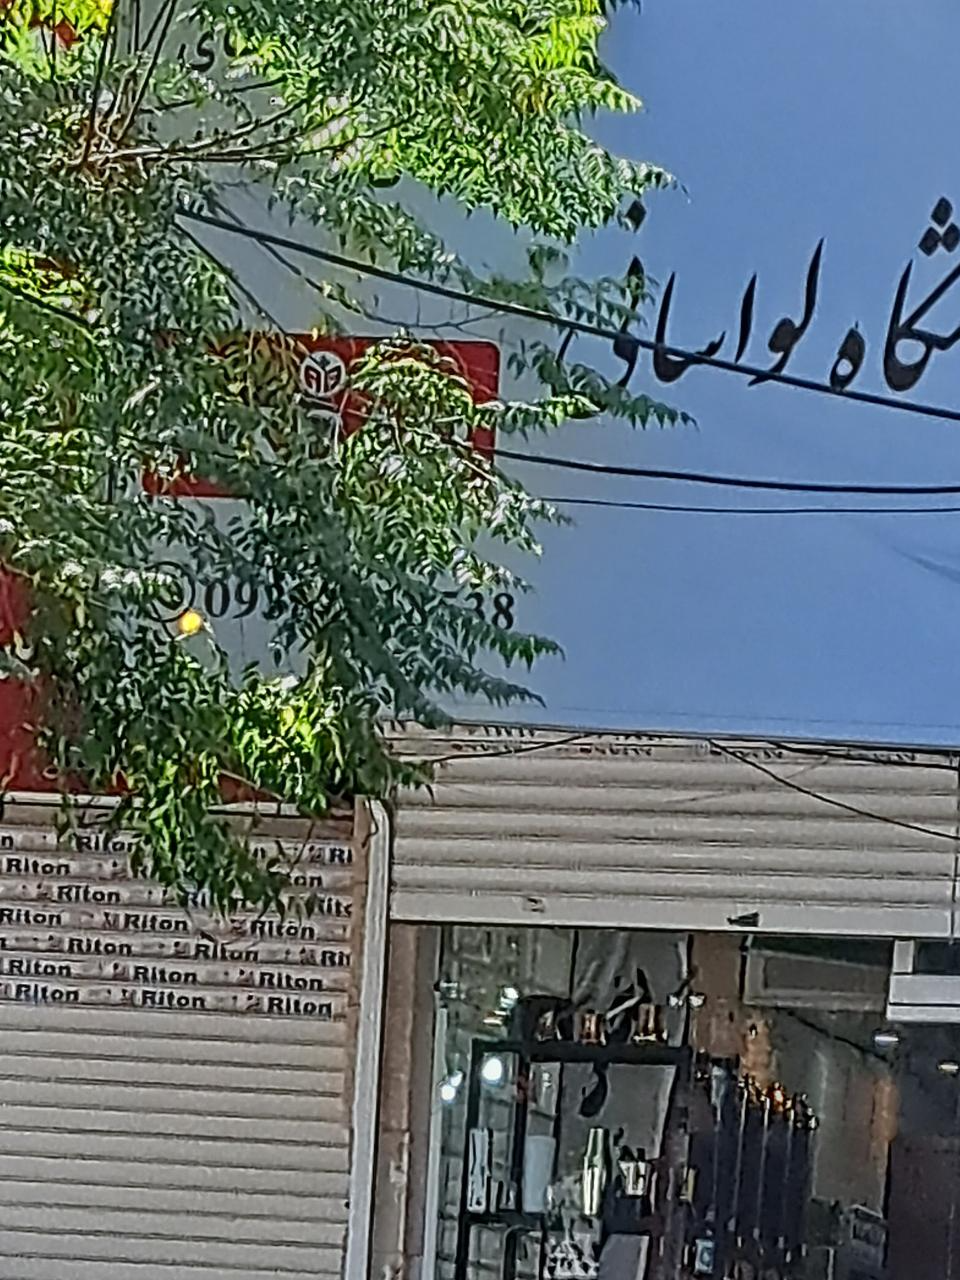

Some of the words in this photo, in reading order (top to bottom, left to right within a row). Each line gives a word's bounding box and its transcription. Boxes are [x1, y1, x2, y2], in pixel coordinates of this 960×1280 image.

[6, 857, 70, 875] Riton
[57, 885, 121, 903] Riton
[124, 913, 188, 931] Riton
[67, 938, 132, 956] Riton
[8, 960, 72, 977] Riton
[134, 965, 198, 985] Riton
[259, 971, 324, 992] Riton
[15, 984, 80, 1004] Riton
[142, 989, 206, 1010] Riton
[267, 996, 332, 1018] Riton
